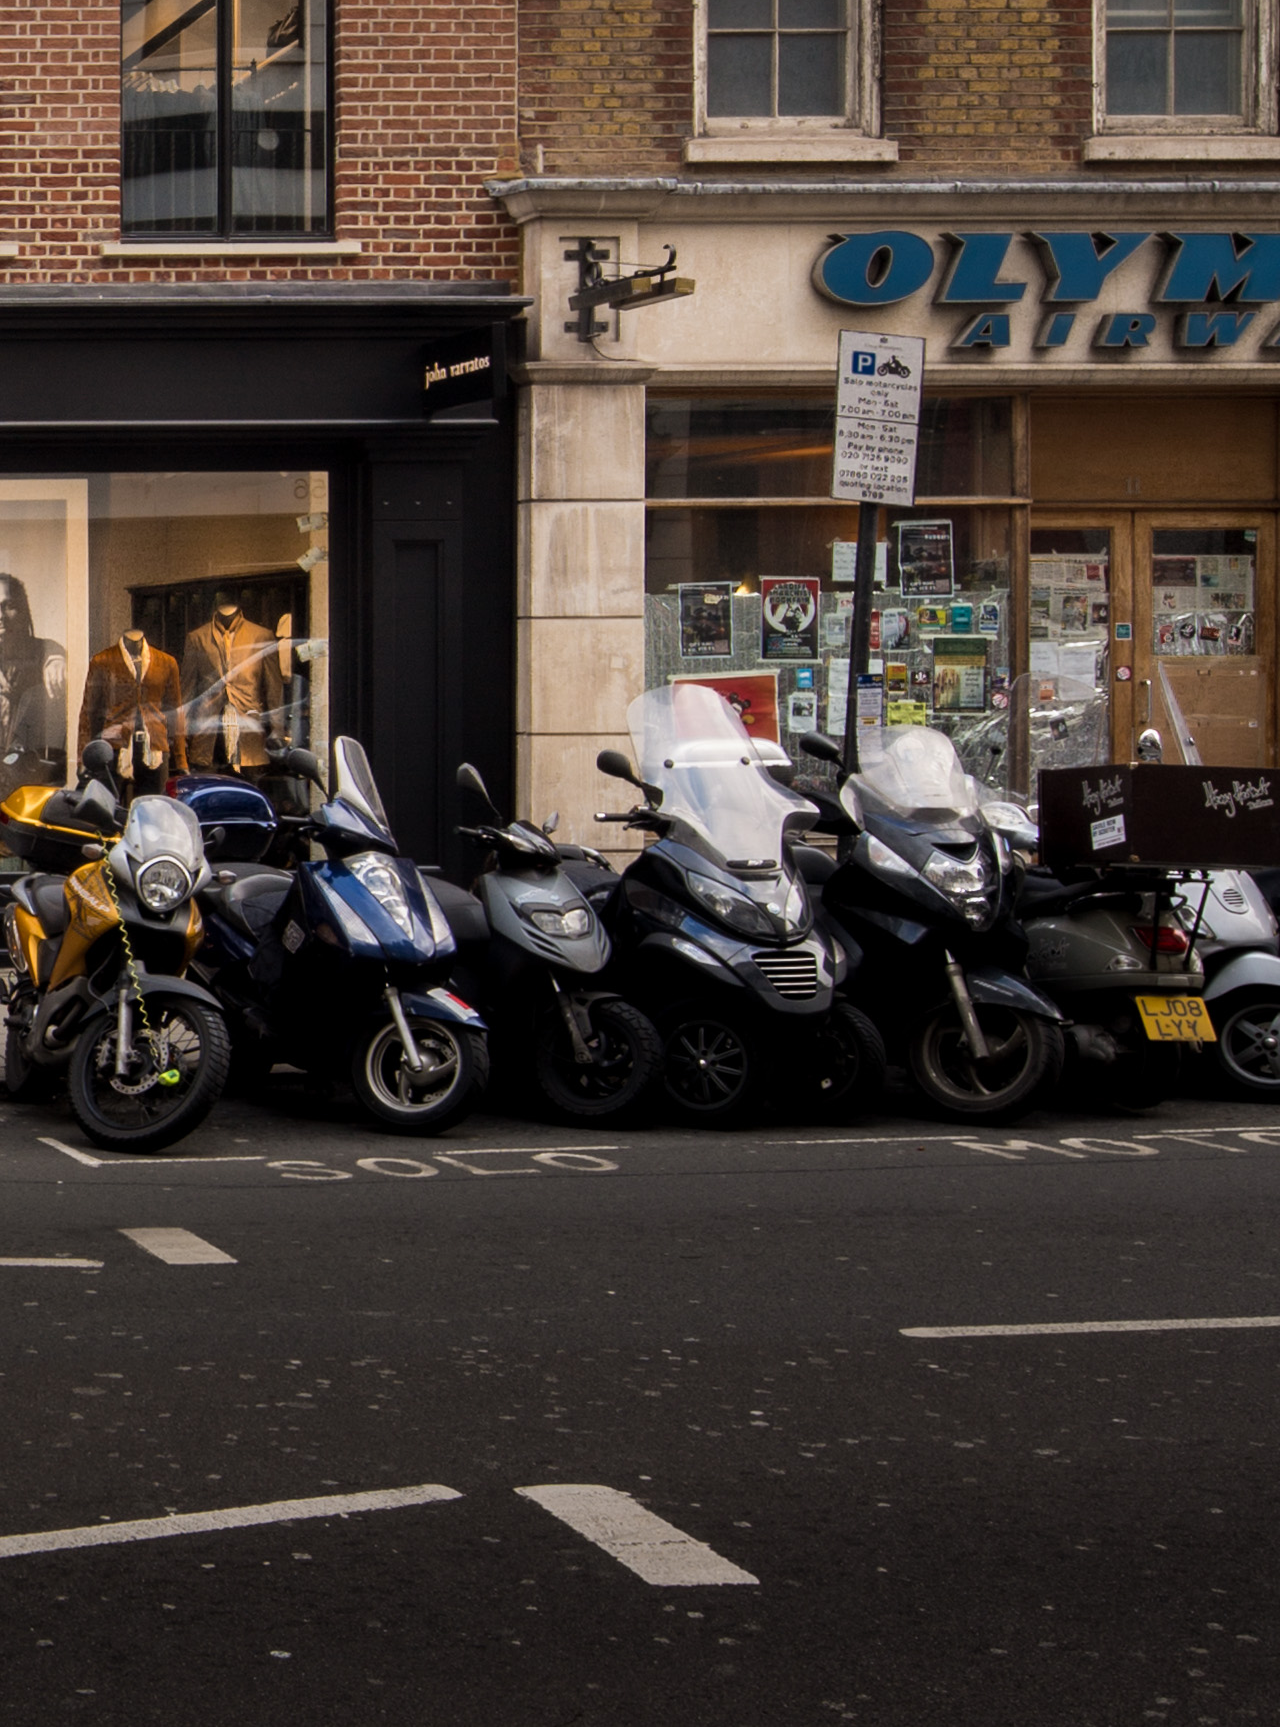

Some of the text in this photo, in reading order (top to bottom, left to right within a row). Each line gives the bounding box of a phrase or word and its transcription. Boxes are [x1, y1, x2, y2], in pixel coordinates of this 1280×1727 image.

[958, 312, 1280, 347] AIRW
[424, 356, 490, 390] john varvatos
[866, 379, 918, 392] motorcycles
[1141, 999, 1202, 1017] LJ08
[265, 1152, 619, 1181] SOLO
